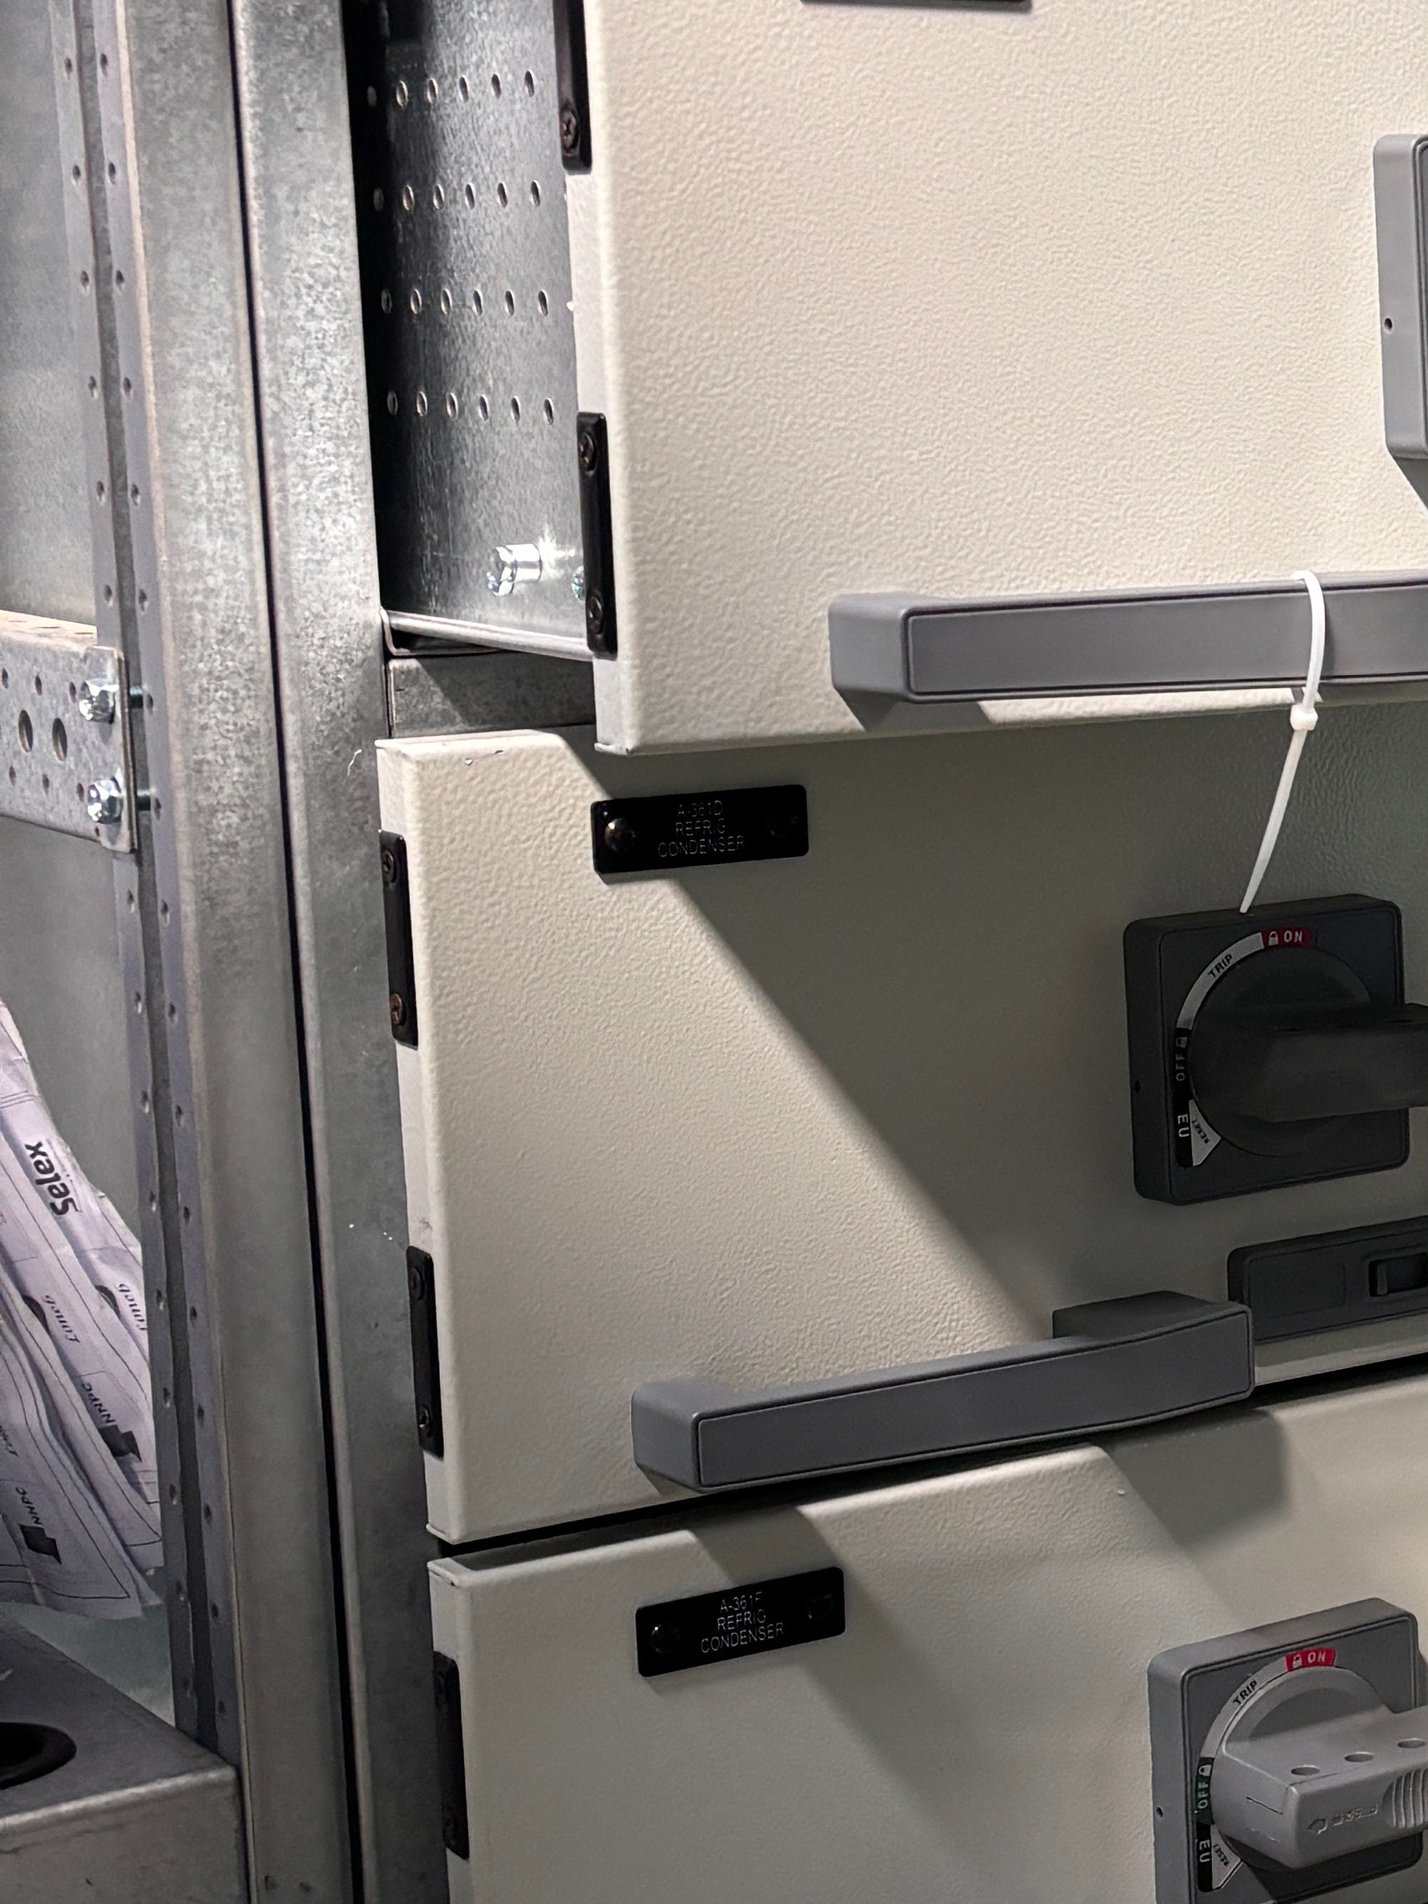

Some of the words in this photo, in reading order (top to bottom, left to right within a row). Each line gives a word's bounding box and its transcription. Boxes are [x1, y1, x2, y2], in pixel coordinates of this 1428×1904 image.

[675, 818, 726, 836] REFRIG
[658, 835, 745, 857] CONDENSER
[1283, 929, 1304, 945] ON
[1209, 953, 1234, 979] TRIP
[1175, 1053, 1186, 1083] OFF
[24, 1141, 79, 1216] Selex
[82, 1382, 116, 1425] NNPC
[16, 1487, 43, 1525] NNPC
[717, 1609, 766, 1631] REFRIG
[701, 1622, 784, 1653] CONDENSER
[1306, 1650, 1327, 1665] ON
[1233, 1679, 1259, 1706] TRIP
[1197, 1781, 1209, 1813] OFF
